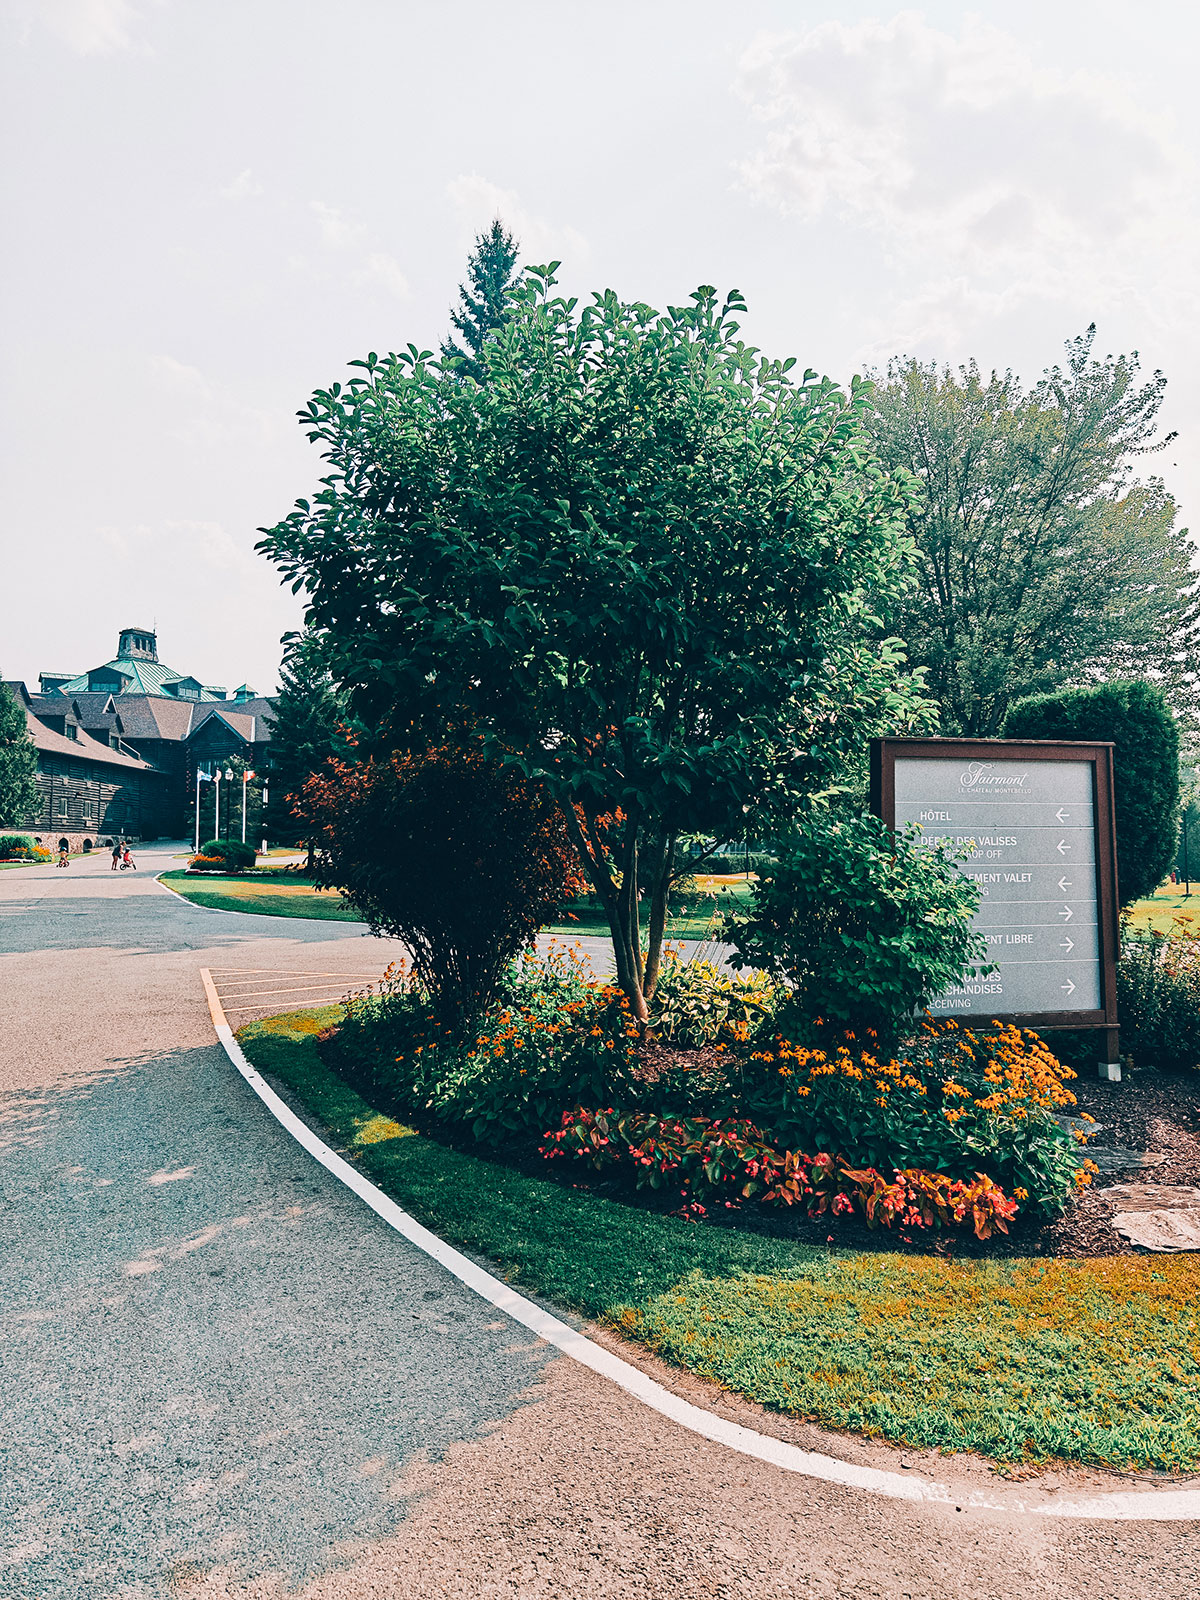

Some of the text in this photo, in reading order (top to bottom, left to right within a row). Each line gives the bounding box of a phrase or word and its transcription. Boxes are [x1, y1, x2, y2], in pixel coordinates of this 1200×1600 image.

[960, 761, 1030, 787] Fairmont
[920, 808, 952, 821] HÔTEL
[956, 836, 976, 846] DES
[979, 836, 1018, 846] VALISES
[986, 850, 1003, 859] OFF
[1003, 873, 1033, 883] VALET
[1006, 934, 1034, 944] LIBRE
